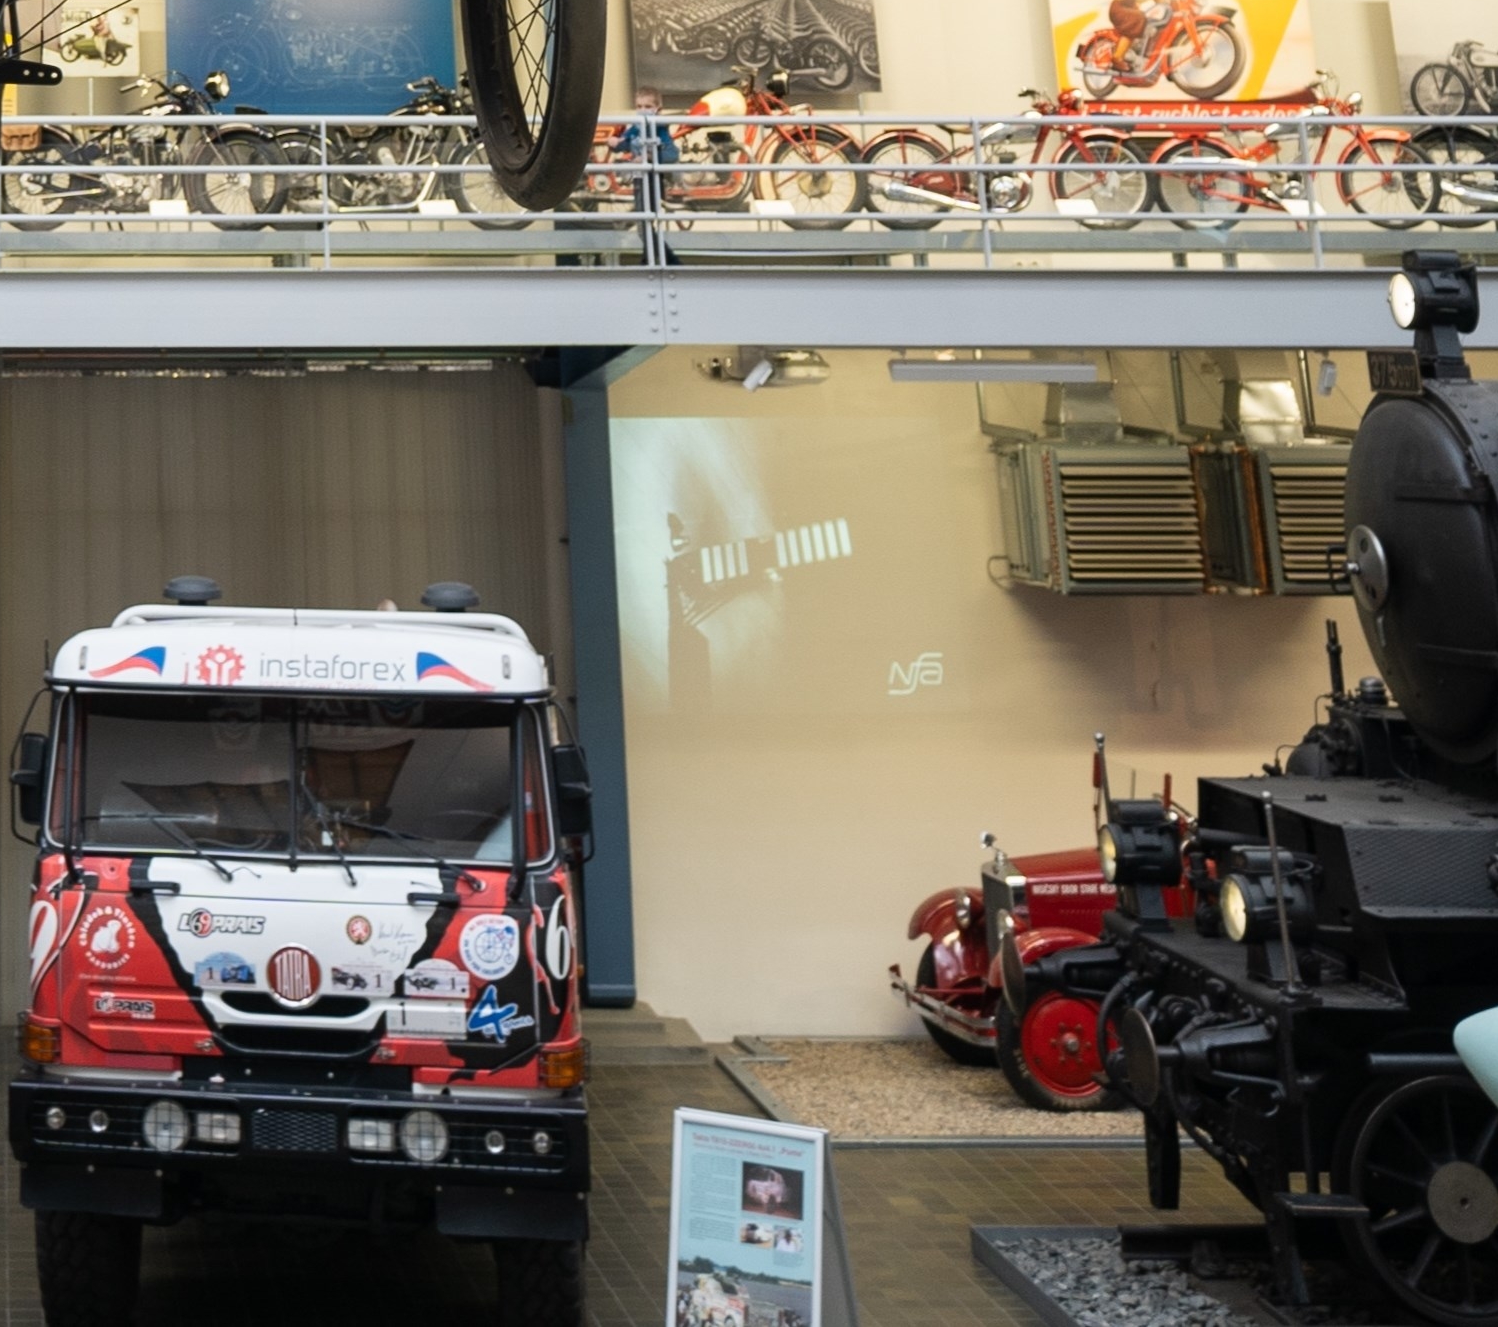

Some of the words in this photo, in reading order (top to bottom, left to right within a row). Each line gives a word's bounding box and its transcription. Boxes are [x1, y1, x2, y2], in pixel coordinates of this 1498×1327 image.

[259, 651, 406, 682] instaforex
[545, 894, 572, 981] 6
[274, 948, 312, 1002] TATRA
[374, 973, 384, 988] 1
